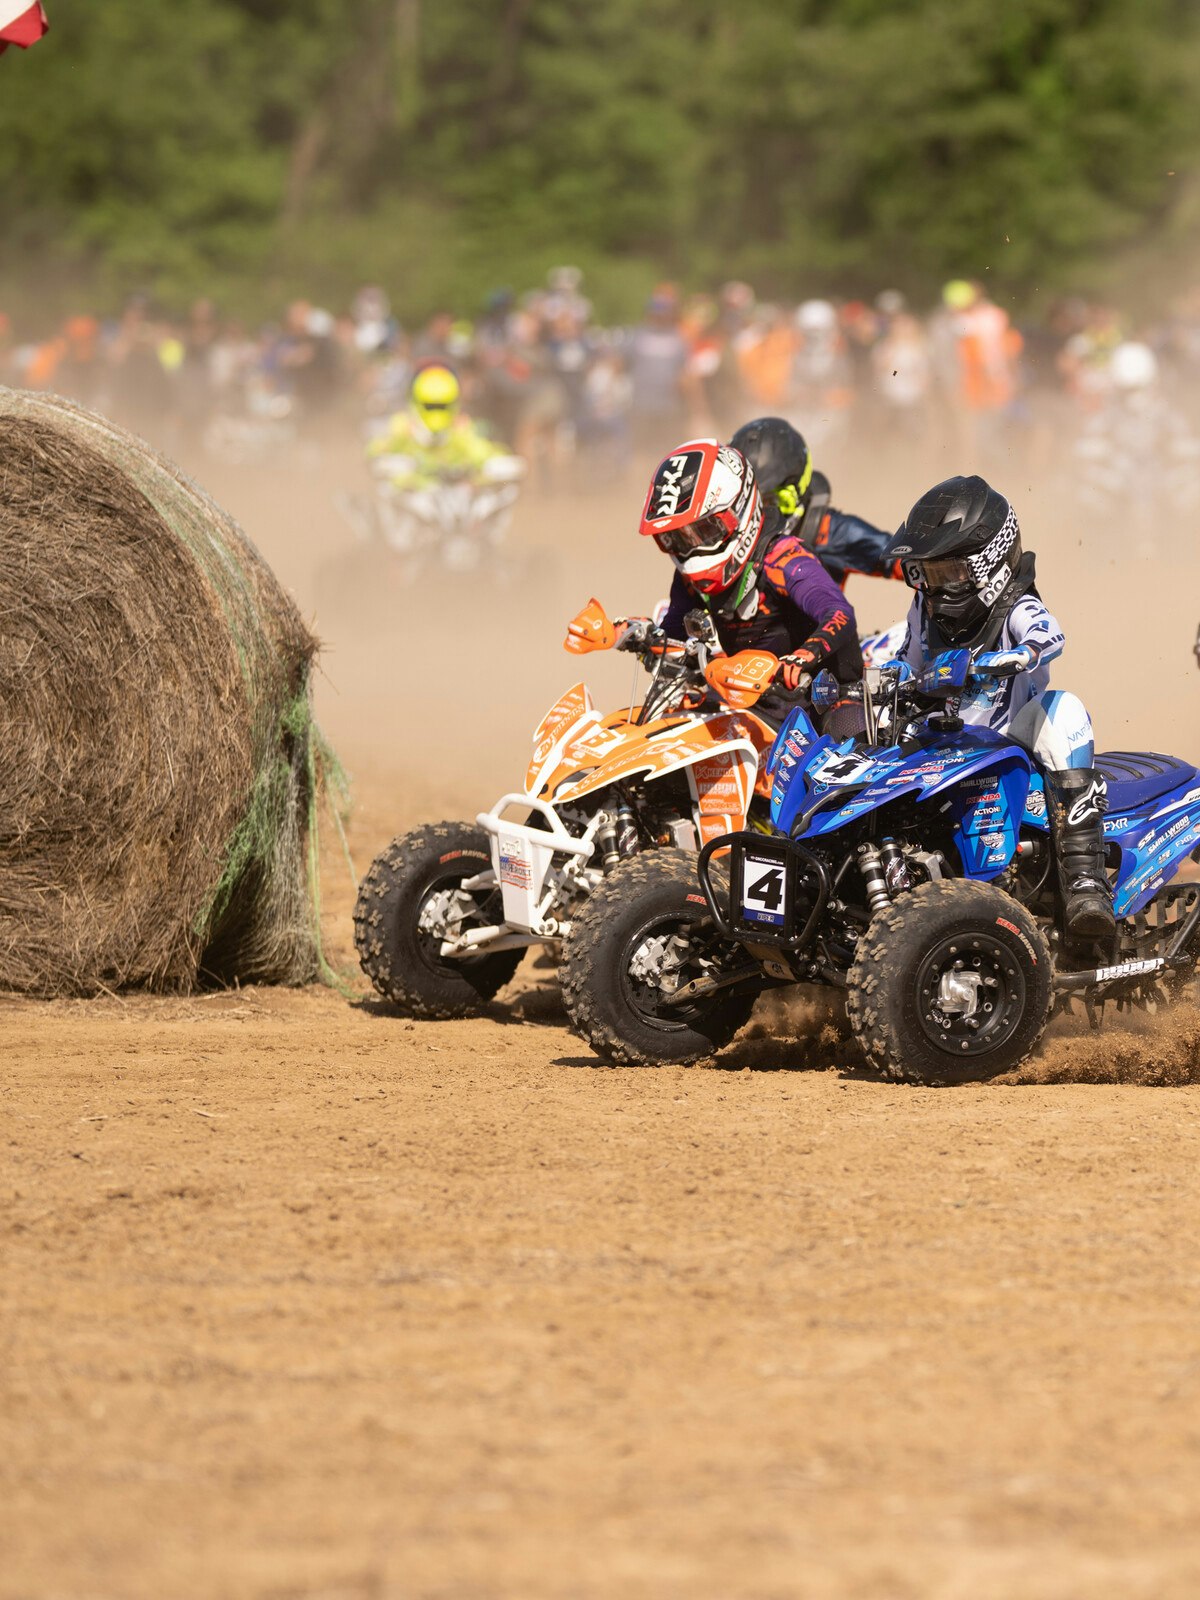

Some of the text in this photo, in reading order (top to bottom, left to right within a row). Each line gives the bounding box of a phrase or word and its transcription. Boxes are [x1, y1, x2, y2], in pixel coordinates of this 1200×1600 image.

[656, 455, 689, 515] FXR
[983, 568, 1012, 602] 004
[822, 609, 849, 636] FXR
[740, 656, 774, 681] 8
[822, 759, 862, 778] 4
[899, 765, 944, 776] KENDA
[960, 775, 998, 789] SMALLWOOD
[1103, 818, 1129, 833] FXR
[1147, 815, 1190, 856] SMALLWOOD
[1175, 834, 1193, 848] FXR
[747, 868, 784, 911] 4
[996, 917, 1039, 961] KENDA HAVOK
